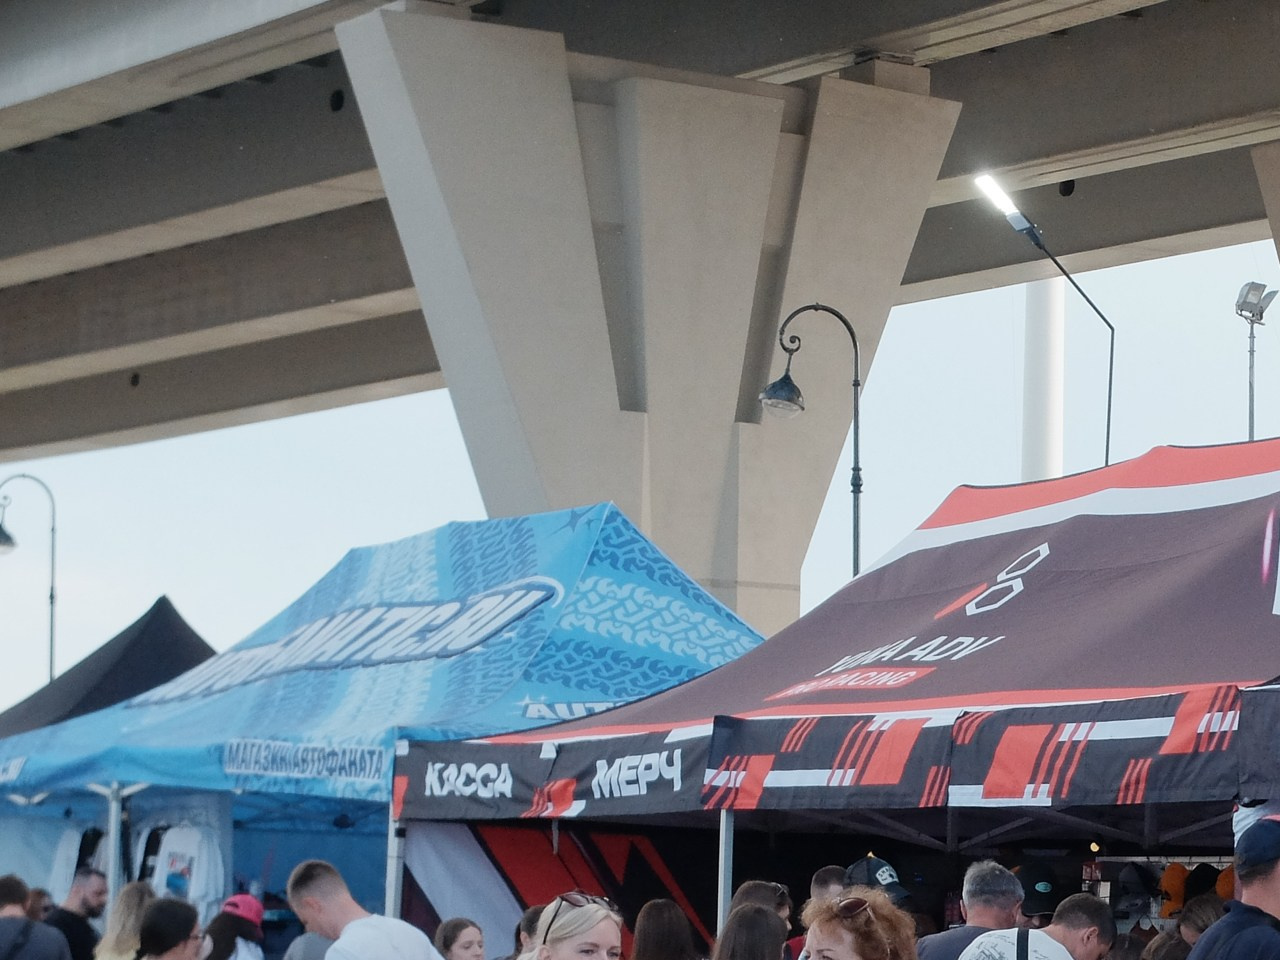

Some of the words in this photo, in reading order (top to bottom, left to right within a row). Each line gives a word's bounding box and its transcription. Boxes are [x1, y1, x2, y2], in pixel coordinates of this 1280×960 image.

[893, 635, 1006, 661] ADV
[828, 670, 917, 687] RACING
[292, 745, 384, 780] АВТОФАНАТА
[424, 761, 513, 798] КАССА
[591, 748, 682, 799] МЕРЧ
